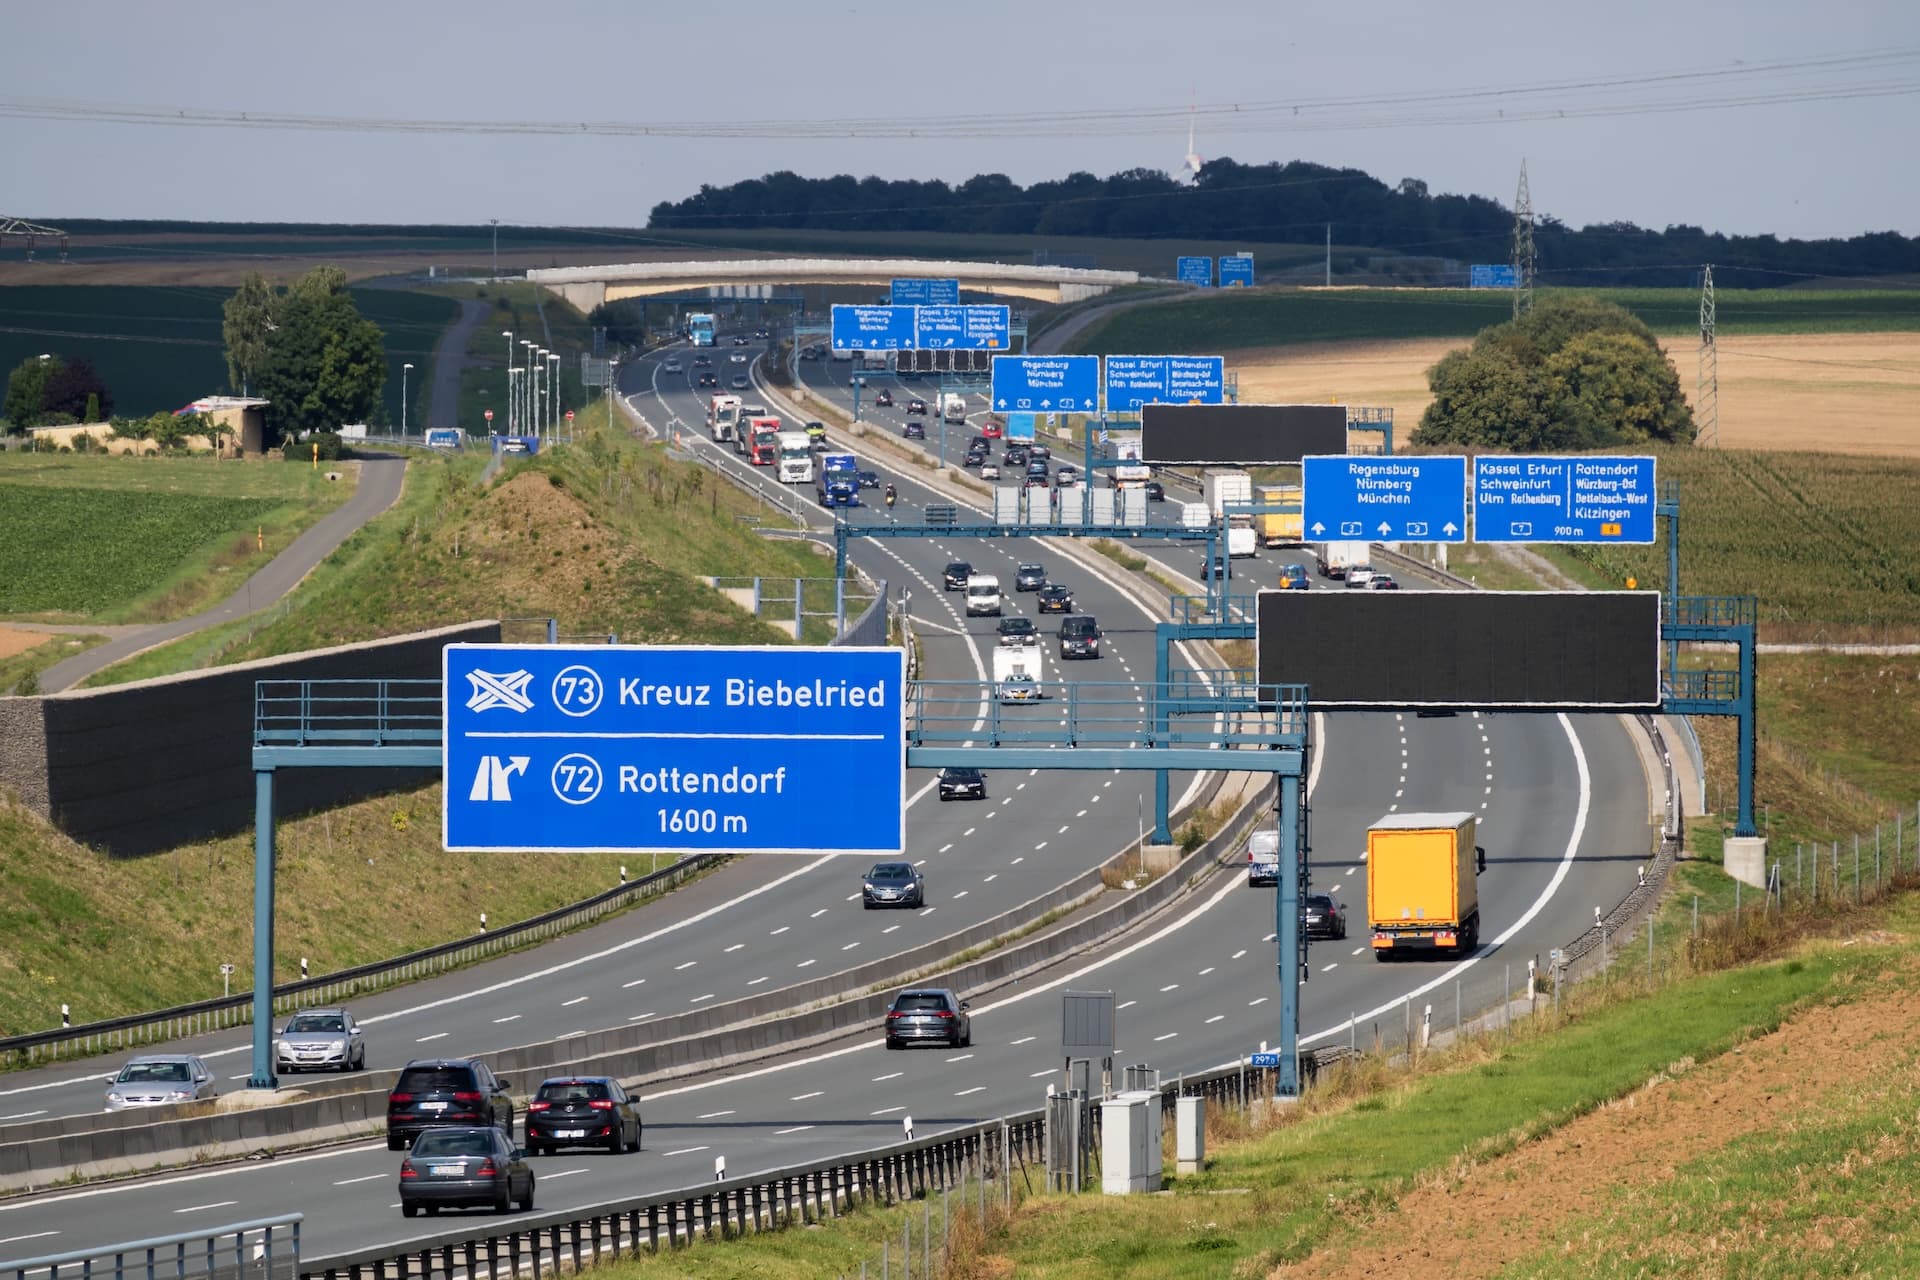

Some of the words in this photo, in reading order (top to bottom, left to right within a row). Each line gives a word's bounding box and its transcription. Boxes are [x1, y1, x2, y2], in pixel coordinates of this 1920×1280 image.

[1349, 463, 1420, 478] Regensburg
[1480, 463, 1520, 475] Kassel
[1527, 463, 1562, 475] Erfurt
[1575, 463, 1638, 475] Rottendorf
[1356, 477, 1412, 492] Nürnberg
[1480, 478, 1551, 490] Schweinfurt
[1575, 477, 1637, 492] Würzburg-Ost
[1357, 492, 1411, 504] München
[1479, 493, 1504, 505] Ulm
[1511, 493, 1562, 506] Rothenburg
[1575, 493, 1648, 505] Dettelbach-West
[1575, 507, 1631, 521] Kitzingen
[1554, 526, 1572, 536] 900
[1573, 528, 1584, 536] m
[560, 677, 595, 705] 73
[620, 678, 710, 706] Kreuz
[726, 679, 885, 707] Biebelried
[560, 766, 594, 793] 72
[619, 766, 786, 794] Rottendorf
[658, 809, 717, 833] 1600
[723, 815, 748, 833] m
